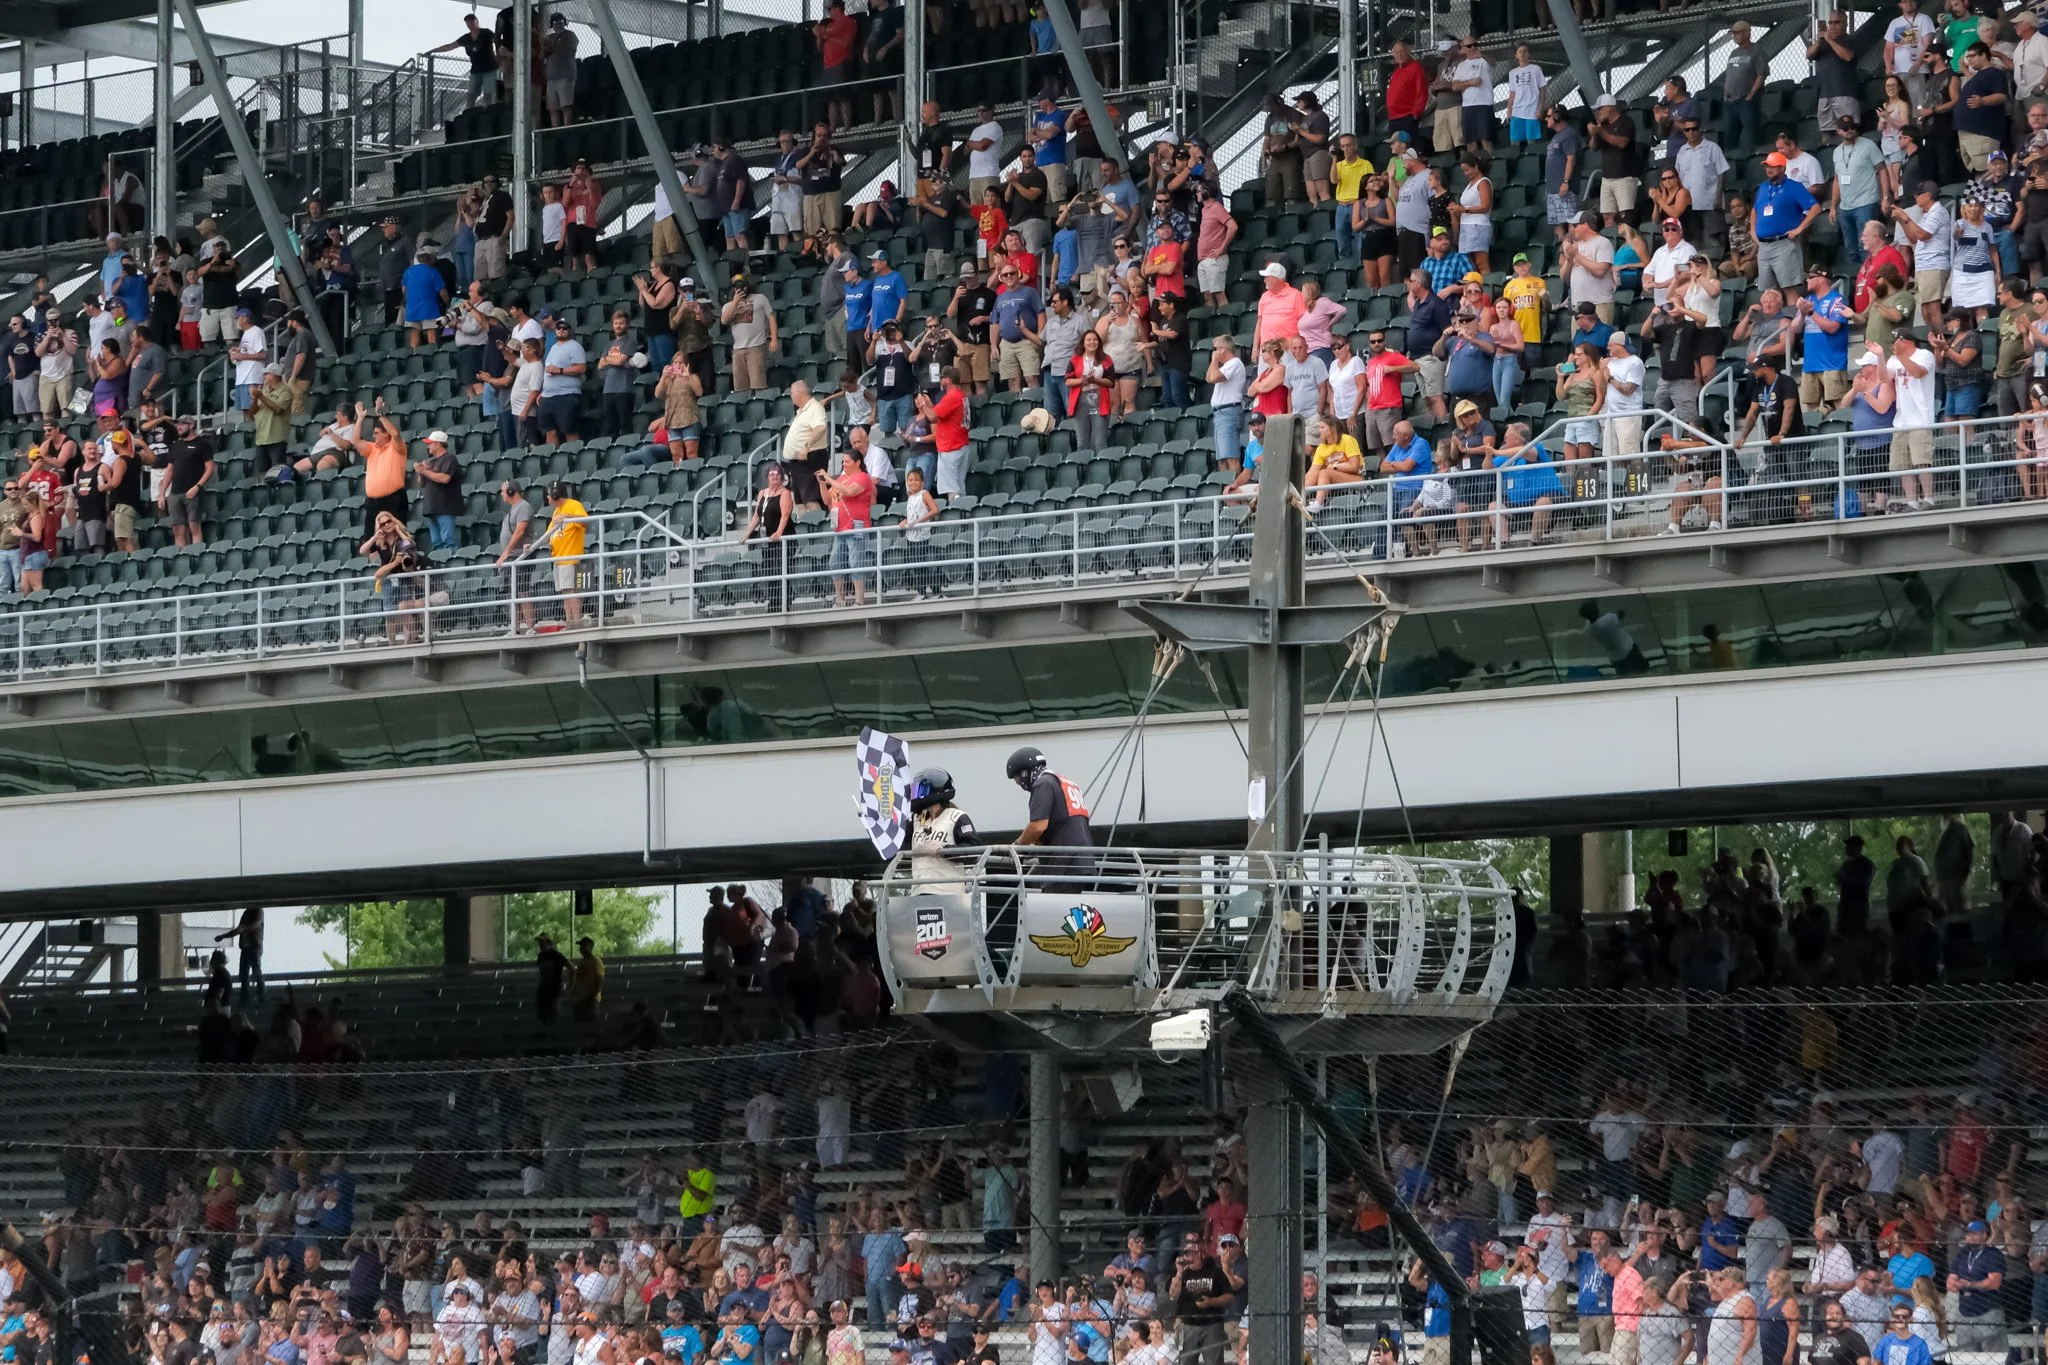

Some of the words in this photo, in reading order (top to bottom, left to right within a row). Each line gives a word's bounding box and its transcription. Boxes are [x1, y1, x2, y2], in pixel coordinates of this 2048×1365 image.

[1370, 68, 1378, 85] 12
[1155, 100, 1162, 116] 11
[1584, 478, 1597, 498] 13
[1636, 472, 1649, 492] 14
[582, 571, 591, 589] 11
[622, 567, 632, 585] 12
[919, 913, 939, 921] verizon
[916, 921, 947, 943] 200
